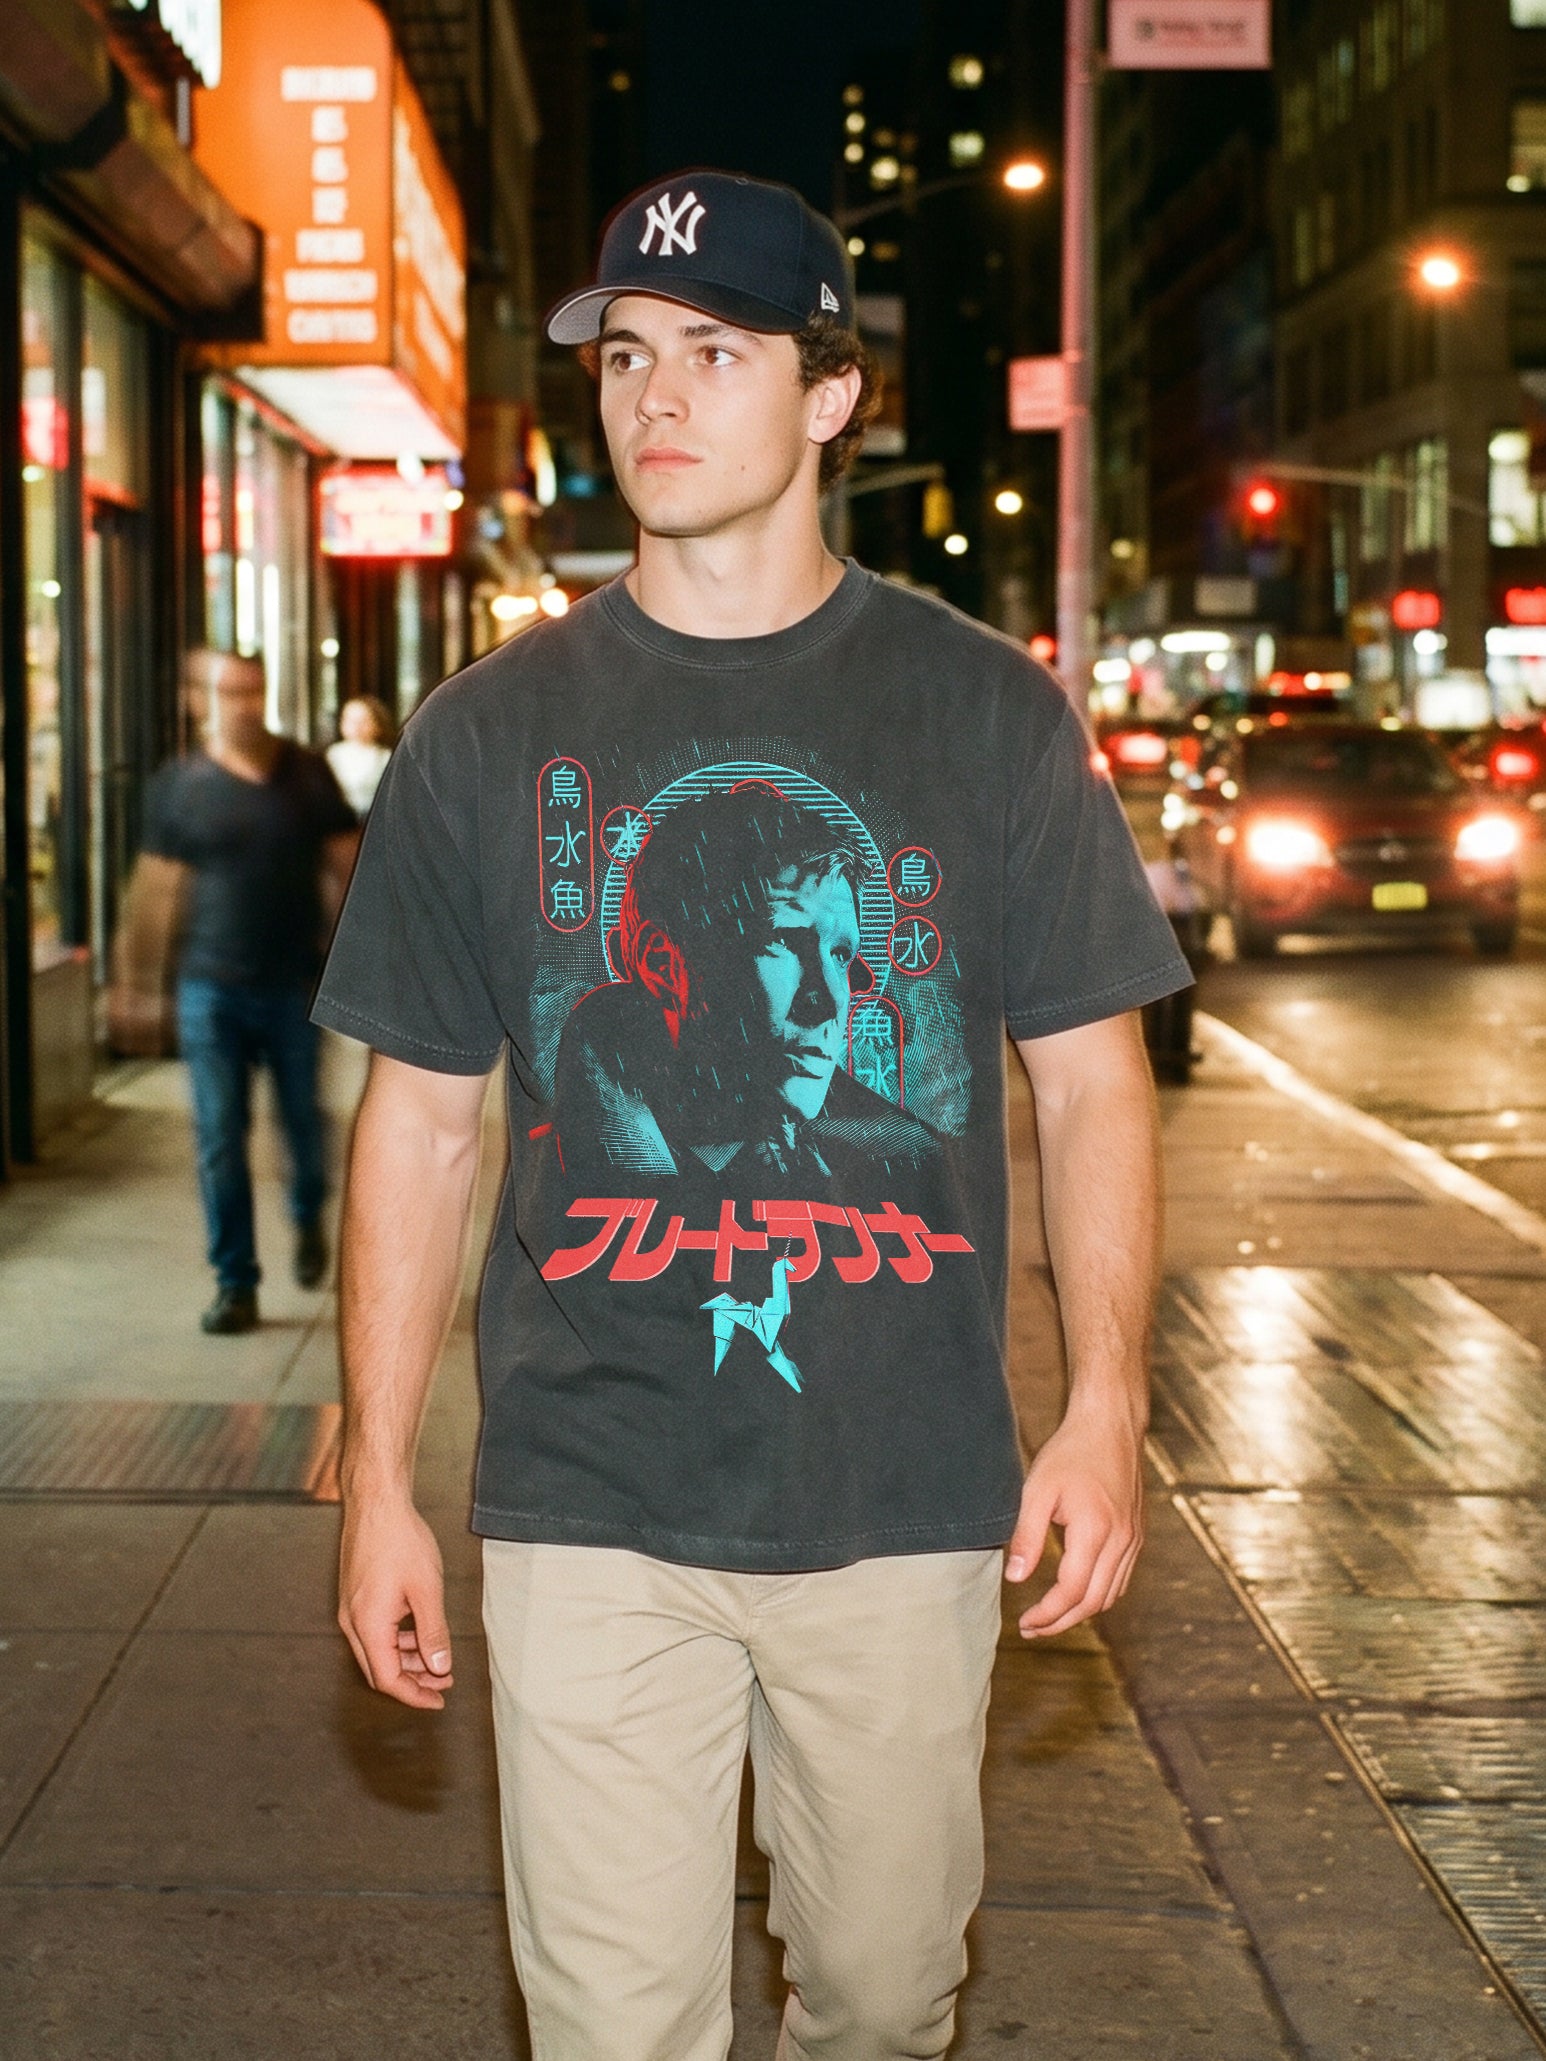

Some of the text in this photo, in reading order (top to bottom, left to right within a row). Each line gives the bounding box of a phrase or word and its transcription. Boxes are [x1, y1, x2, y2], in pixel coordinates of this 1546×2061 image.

[544, 765, 586, 919] 鳥水魚
[893, 921, 935, 969] 水
